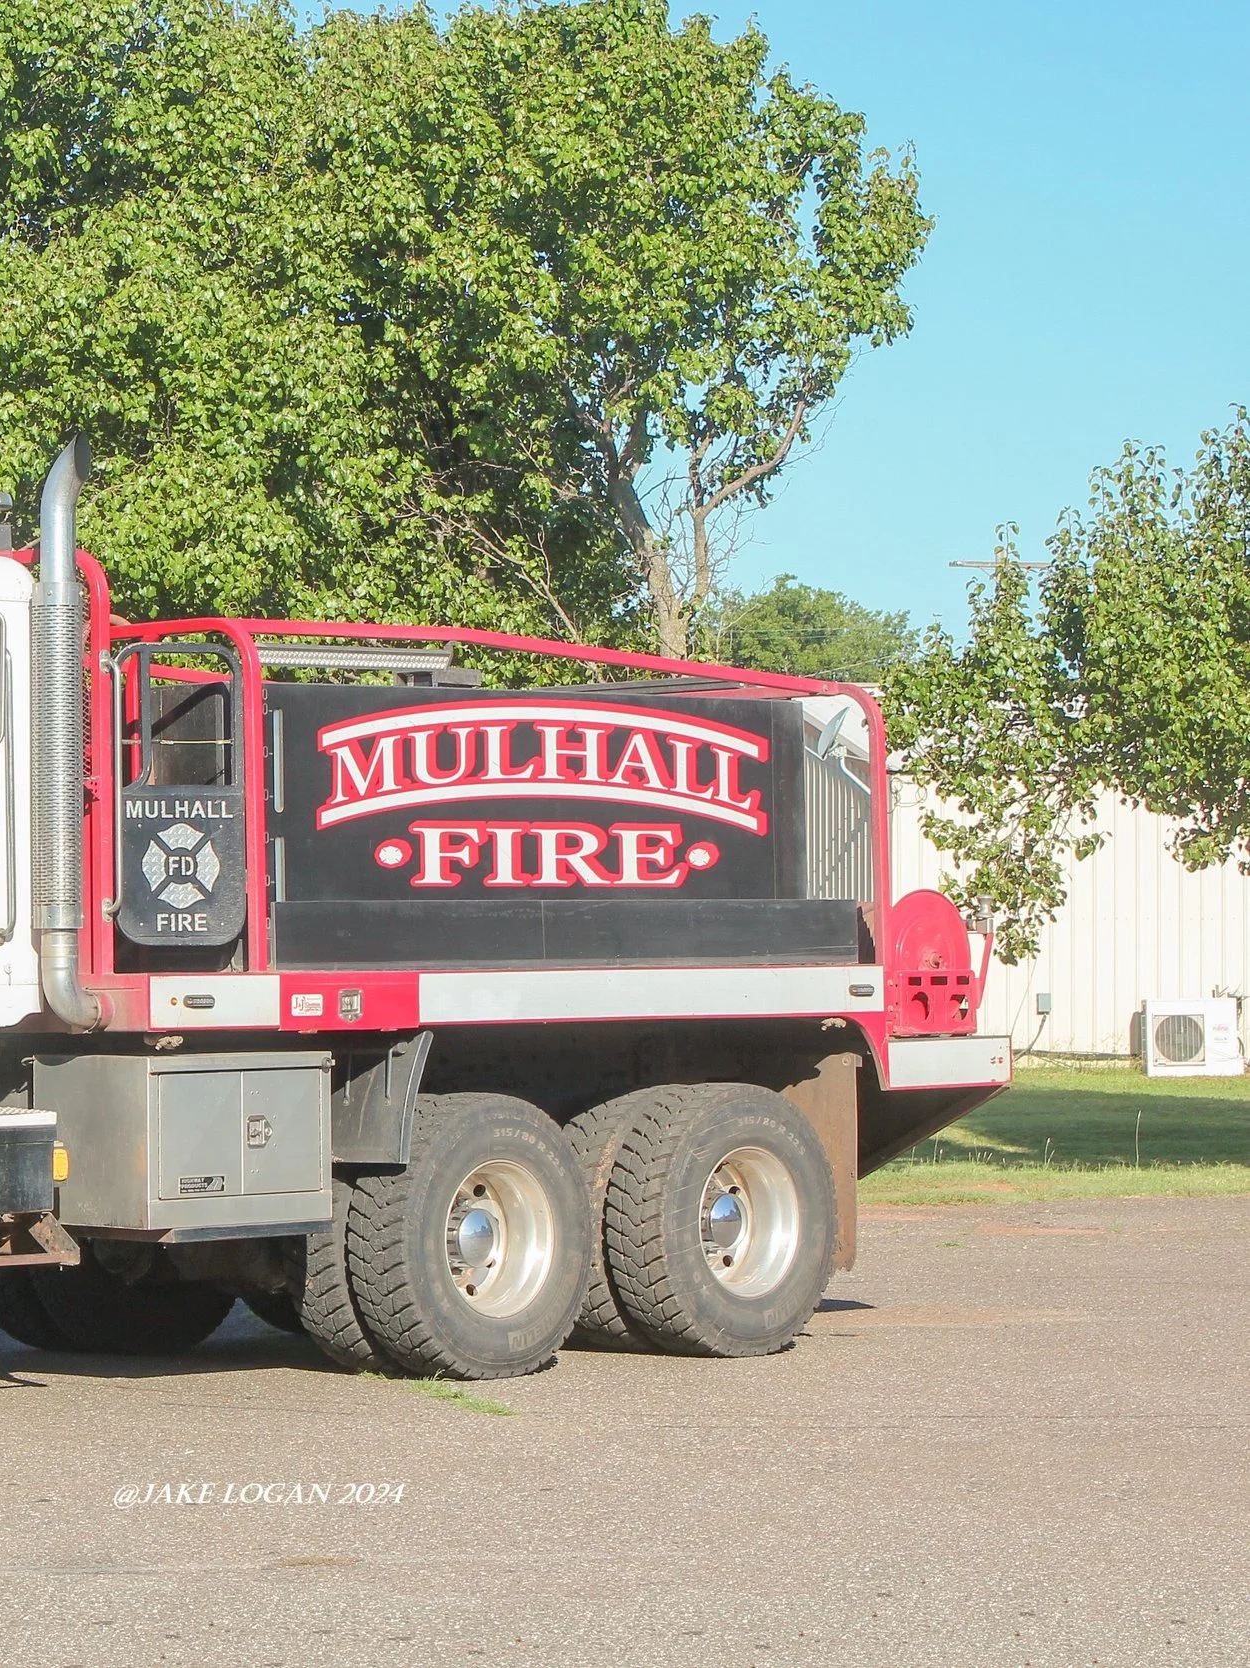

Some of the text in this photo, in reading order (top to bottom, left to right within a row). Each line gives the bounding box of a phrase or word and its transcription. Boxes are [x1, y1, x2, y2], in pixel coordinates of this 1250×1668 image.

[329, 724, 755, 811] MULHALL
[125, 800, 234, 819] MULHALL
[411, 823, 685, 886] FIRE
[167, 856, 195, 876] FD
[156, 913, 208, 932] FIRE
